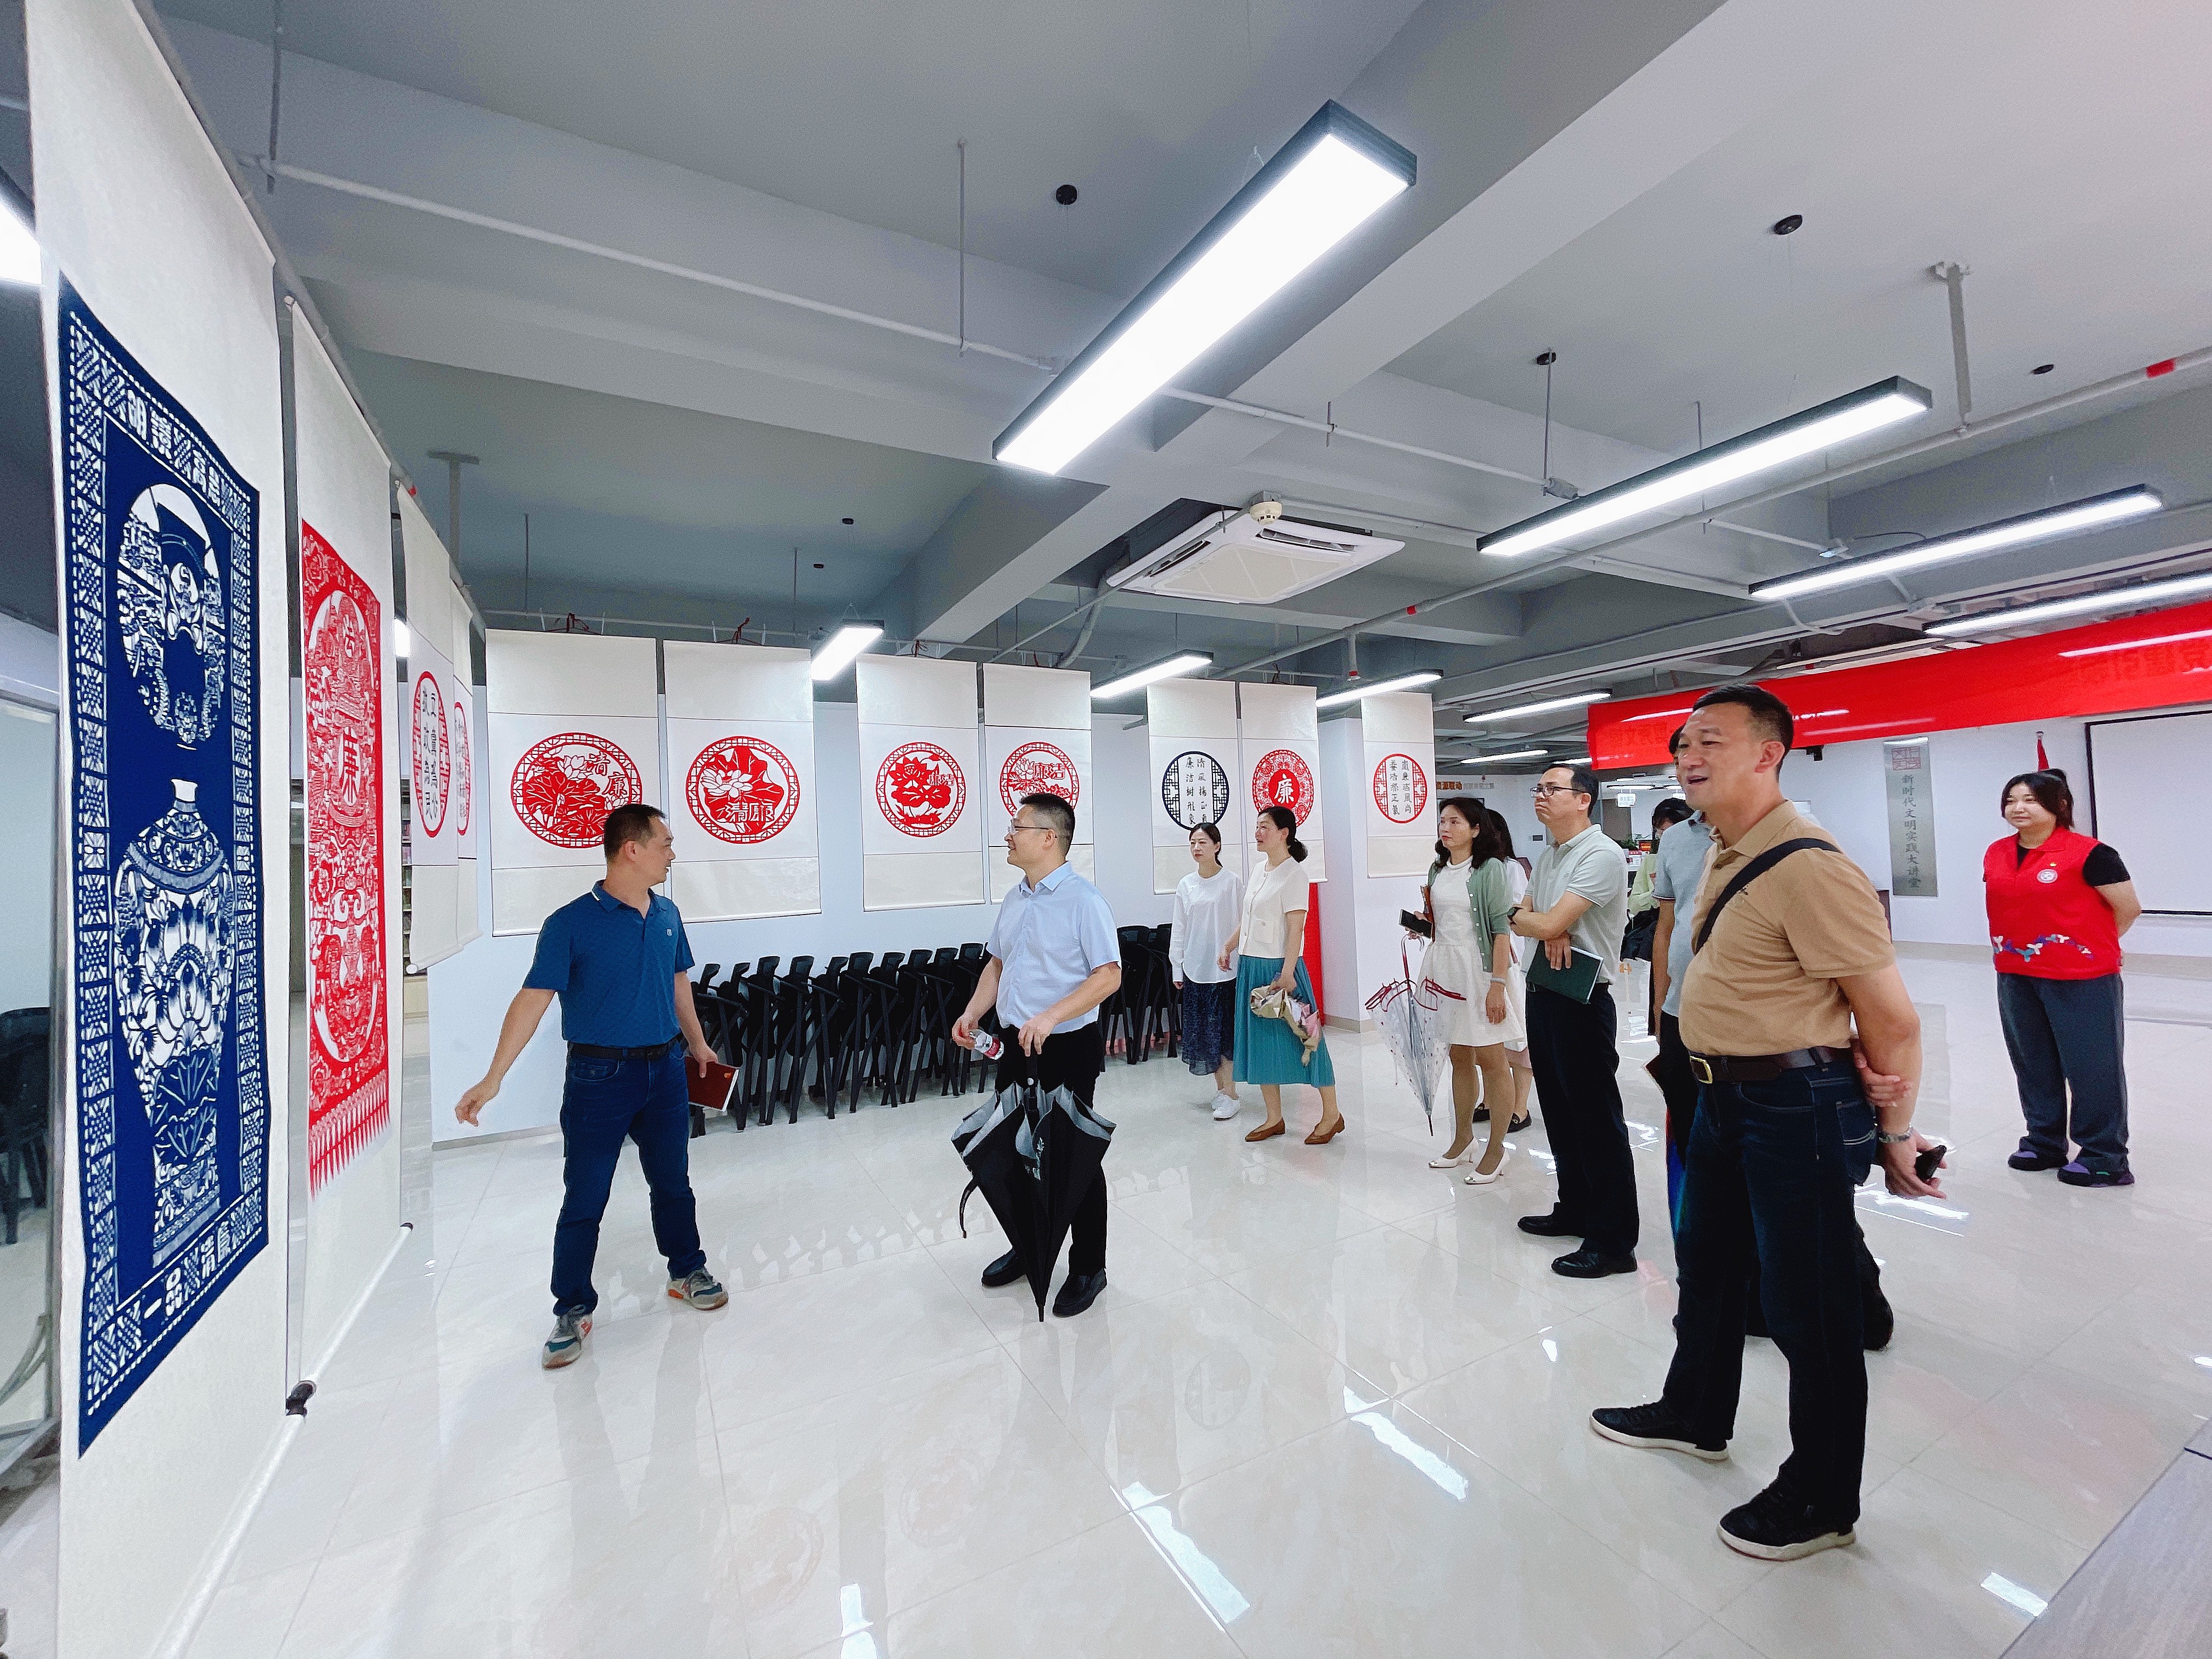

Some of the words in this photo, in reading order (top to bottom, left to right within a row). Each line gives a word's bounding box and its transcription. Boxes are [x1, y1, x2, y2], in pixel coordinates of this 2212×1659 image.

[585, 751, 627, 796] 清廉
[1274, 773, 1294, 804] 廉
[725, 801, 774, 822] 清廉
[1901, 774, 1921, 889] 新时代文明实践大讲堂
